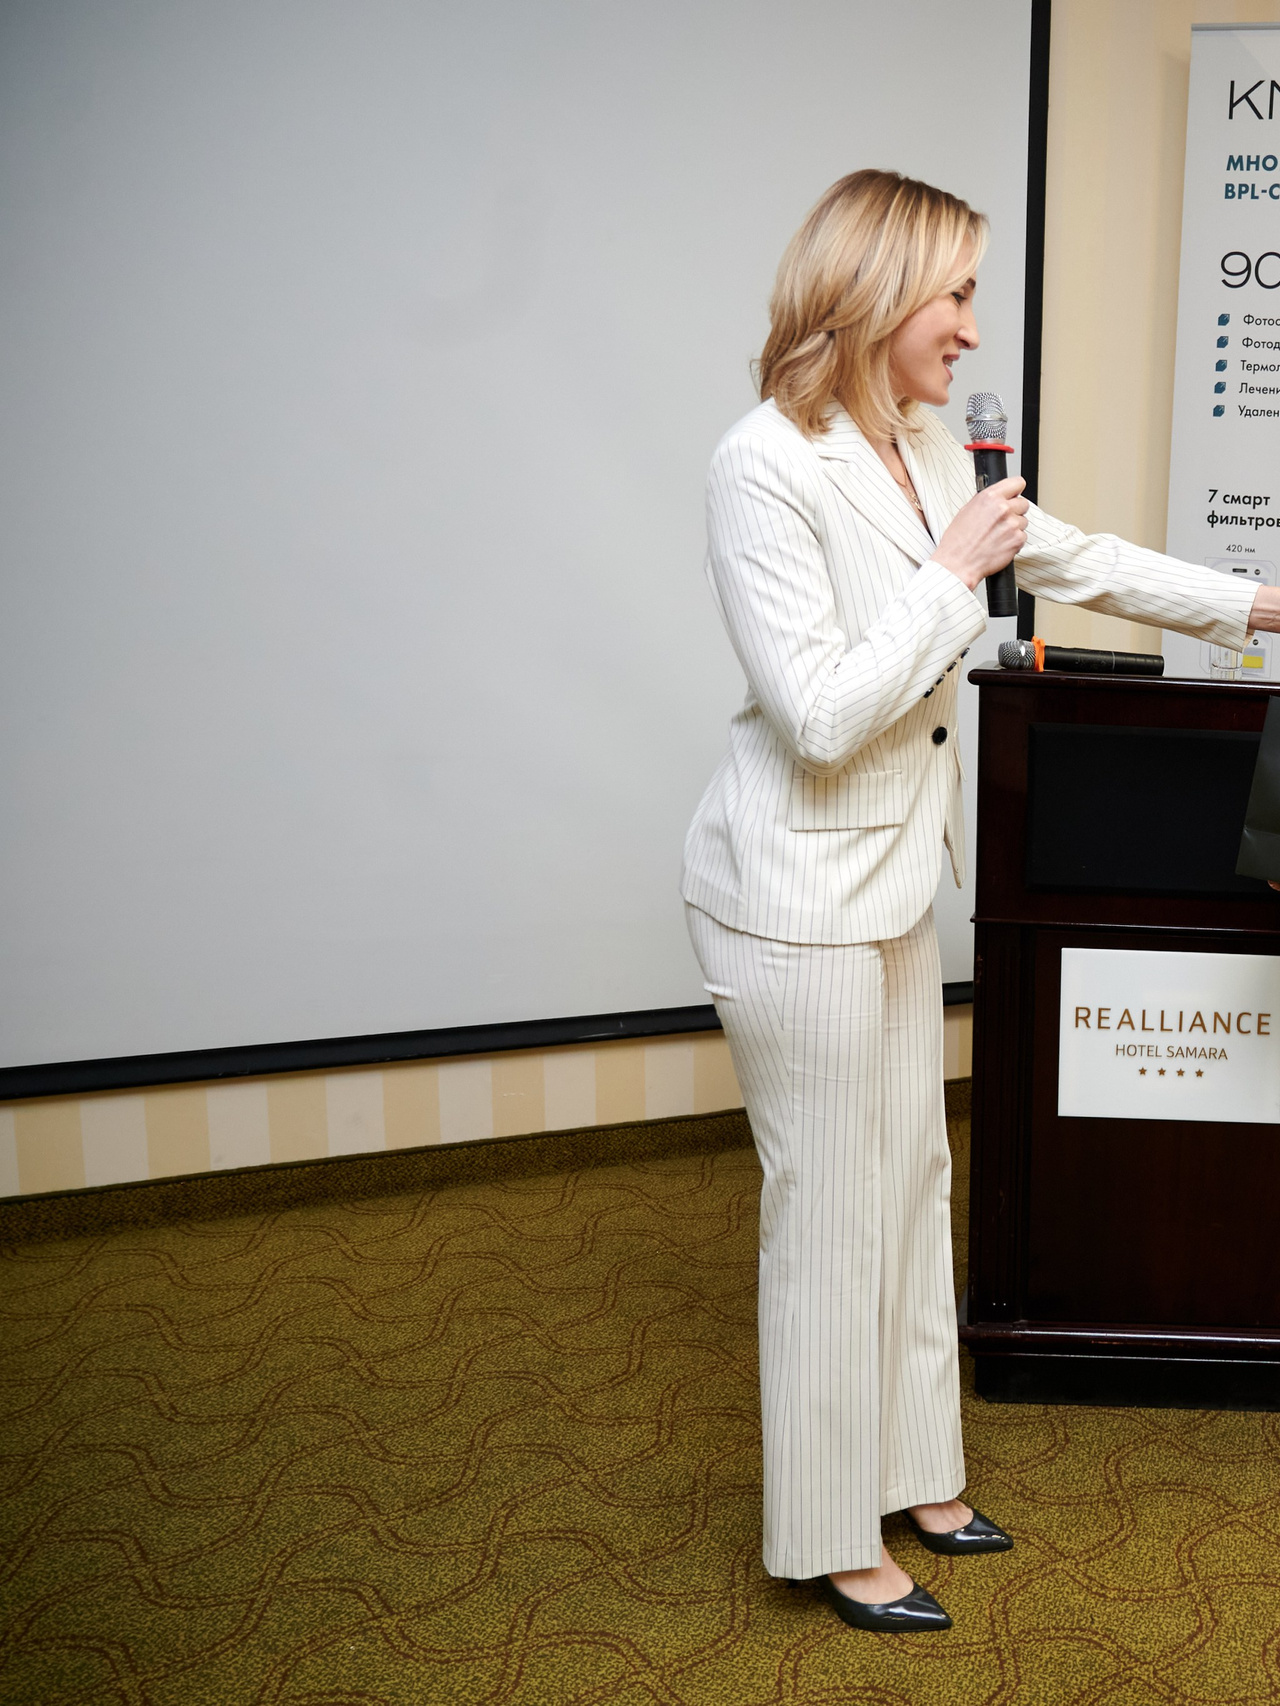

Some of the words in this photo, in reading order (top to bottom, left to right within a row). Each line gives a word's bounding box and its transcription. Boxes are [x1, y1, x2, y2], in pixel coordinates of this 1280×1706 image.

[1208, 488, 1219, 503] 7
[1222, 494, 1271, 510] смарт
[1225, 543, 1243, 553] 420
[1074, 1006, 1274, 1038] REALLIANCE
[1115, 1043, 1163, 1058] HOTEL
[1166, 1045, 1229, 1061] SAMARA
